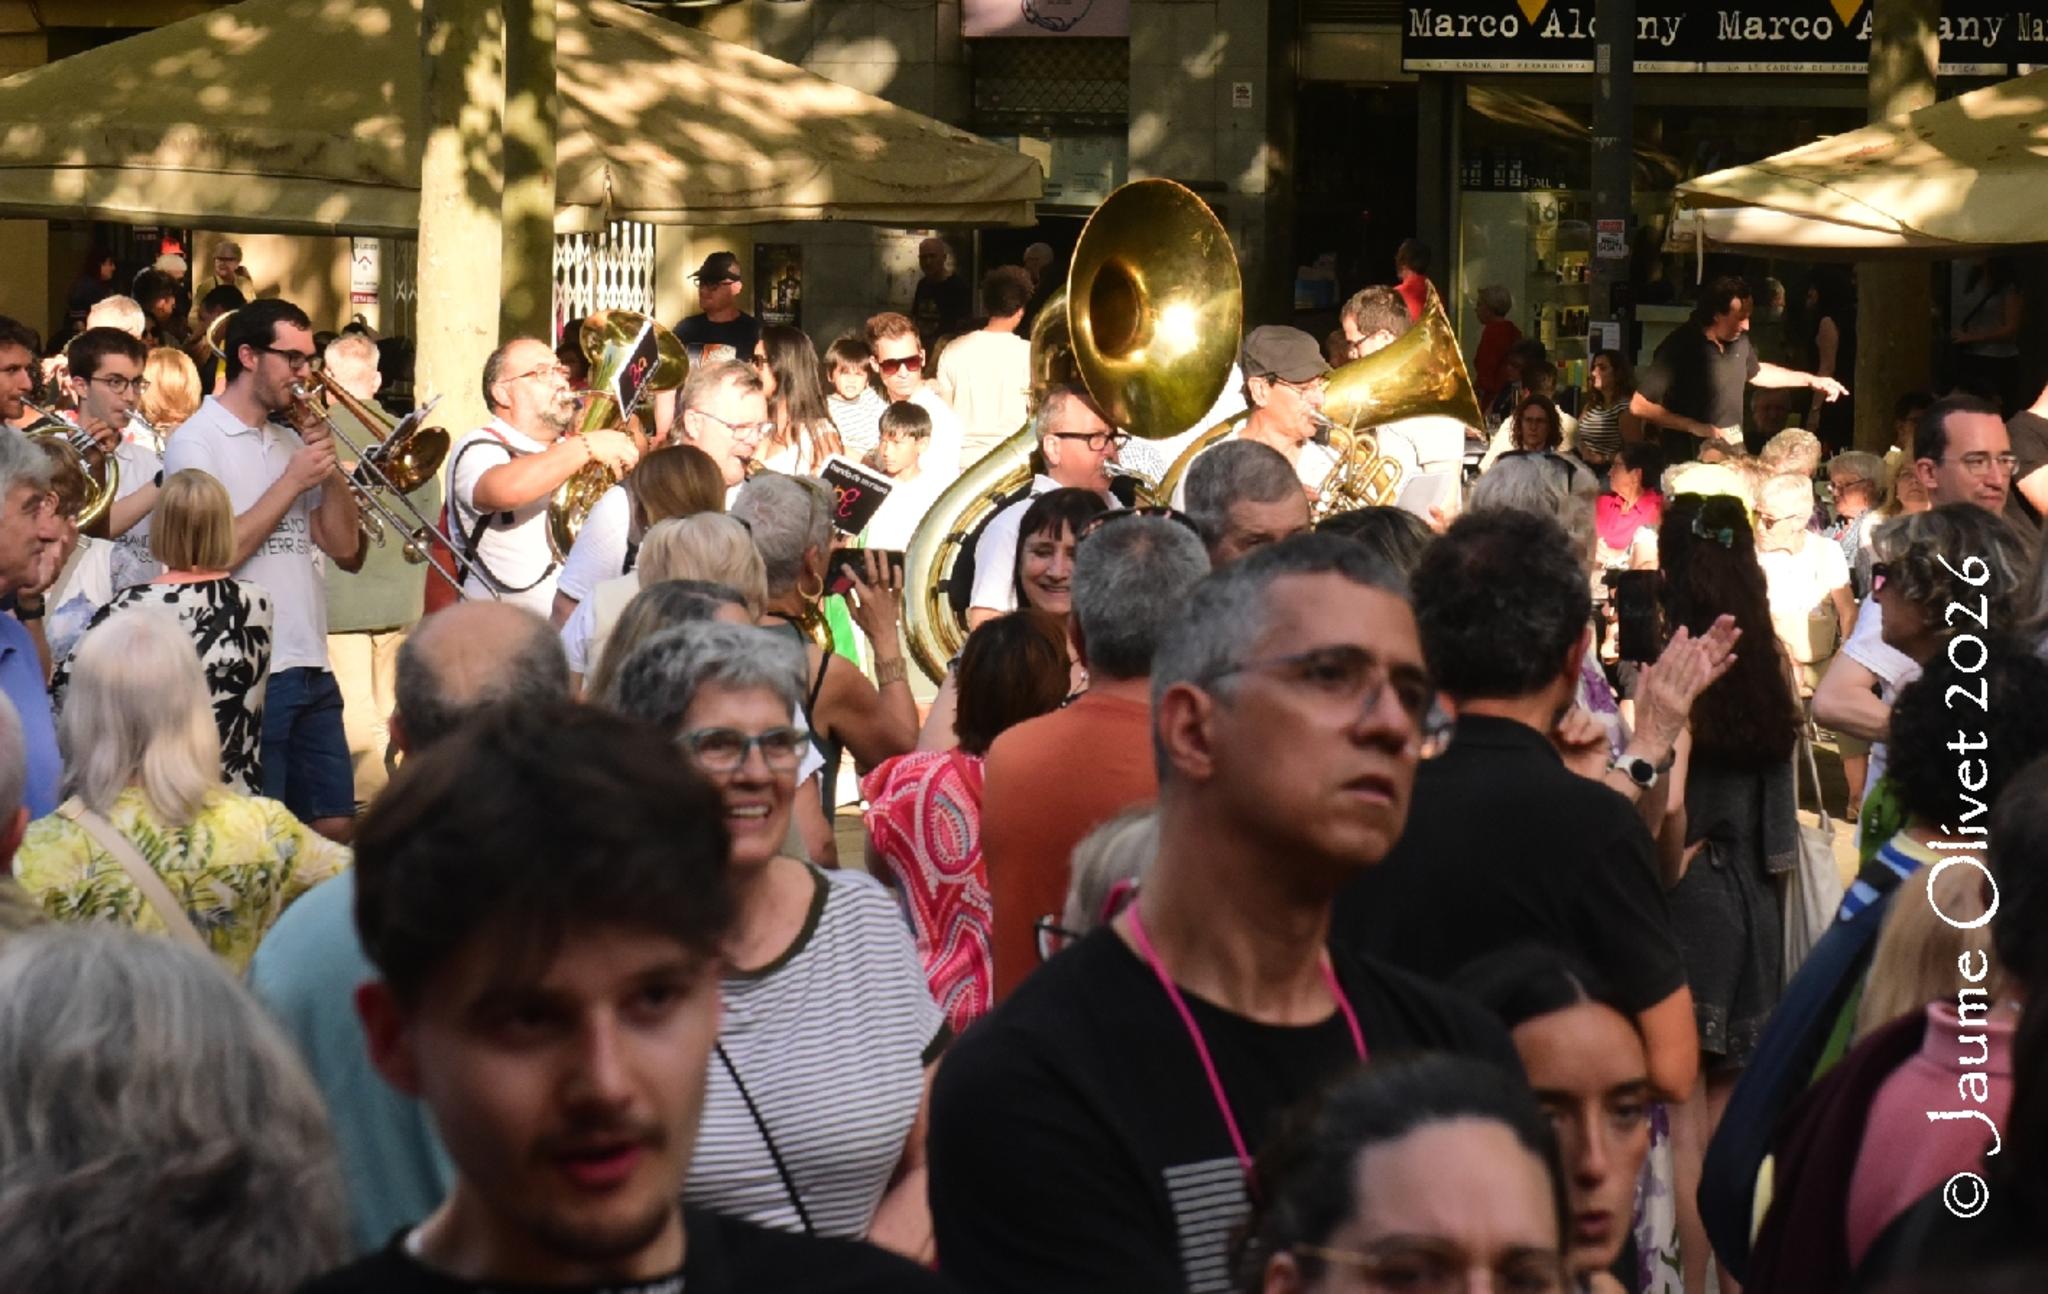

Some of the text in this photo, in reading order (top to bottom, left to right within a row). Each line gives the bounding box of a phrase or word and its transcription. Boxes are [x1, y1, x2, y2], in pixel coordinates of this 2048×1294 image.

[1408, 8, 1683, 47] Marco Alny
[1717, 9, 1833, 41] Marco
[2017, 12, 2048, 42] Ma
